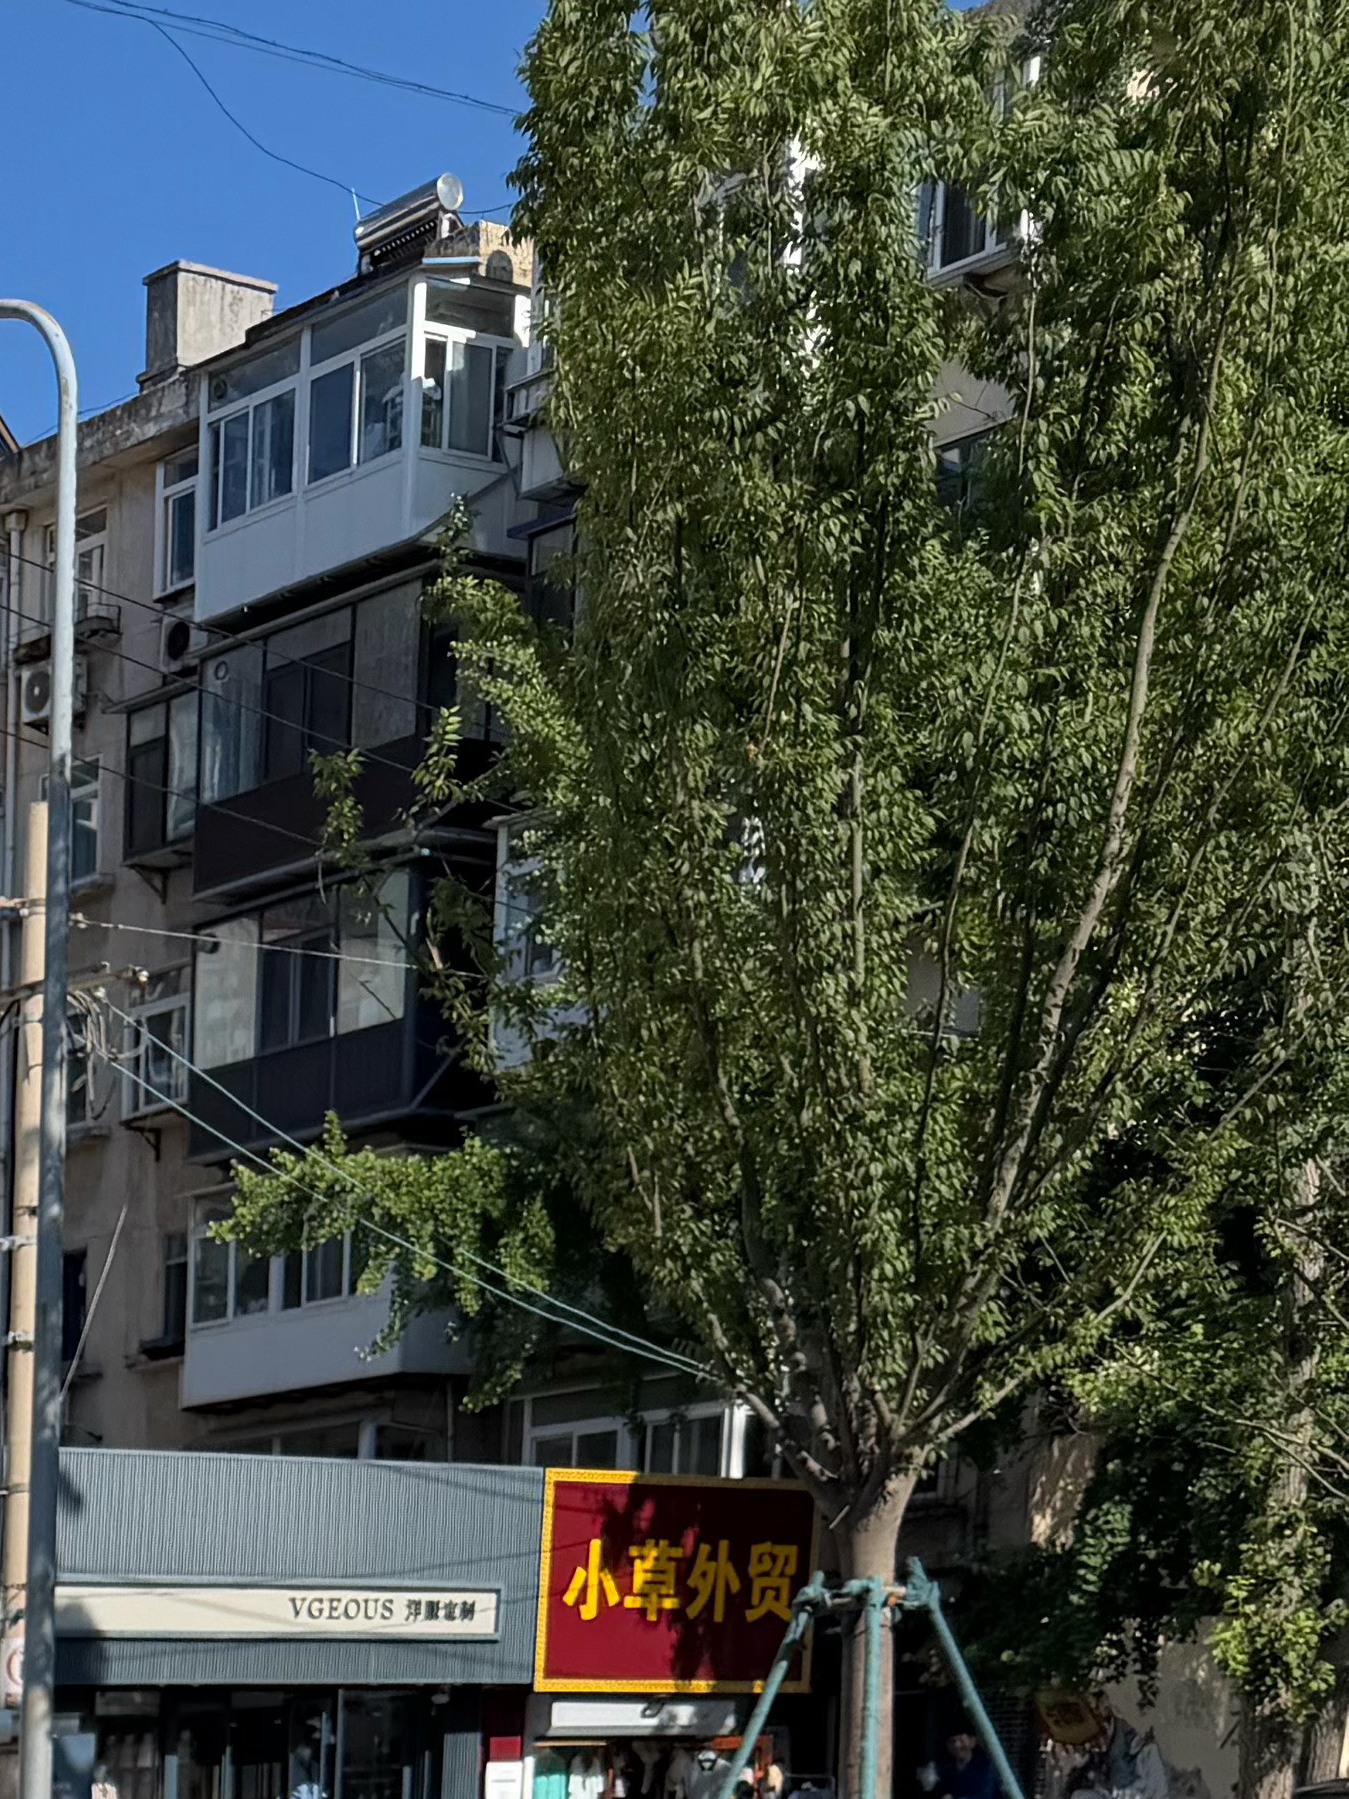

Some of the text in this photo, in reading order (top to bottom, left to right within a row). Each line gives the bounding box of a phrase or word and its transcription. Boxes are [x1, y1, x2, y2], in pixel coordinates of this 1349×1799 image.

[562, 1539, 799, 1622] 小草外贸
[288, 1597, 394, 1621] VGEOUS
